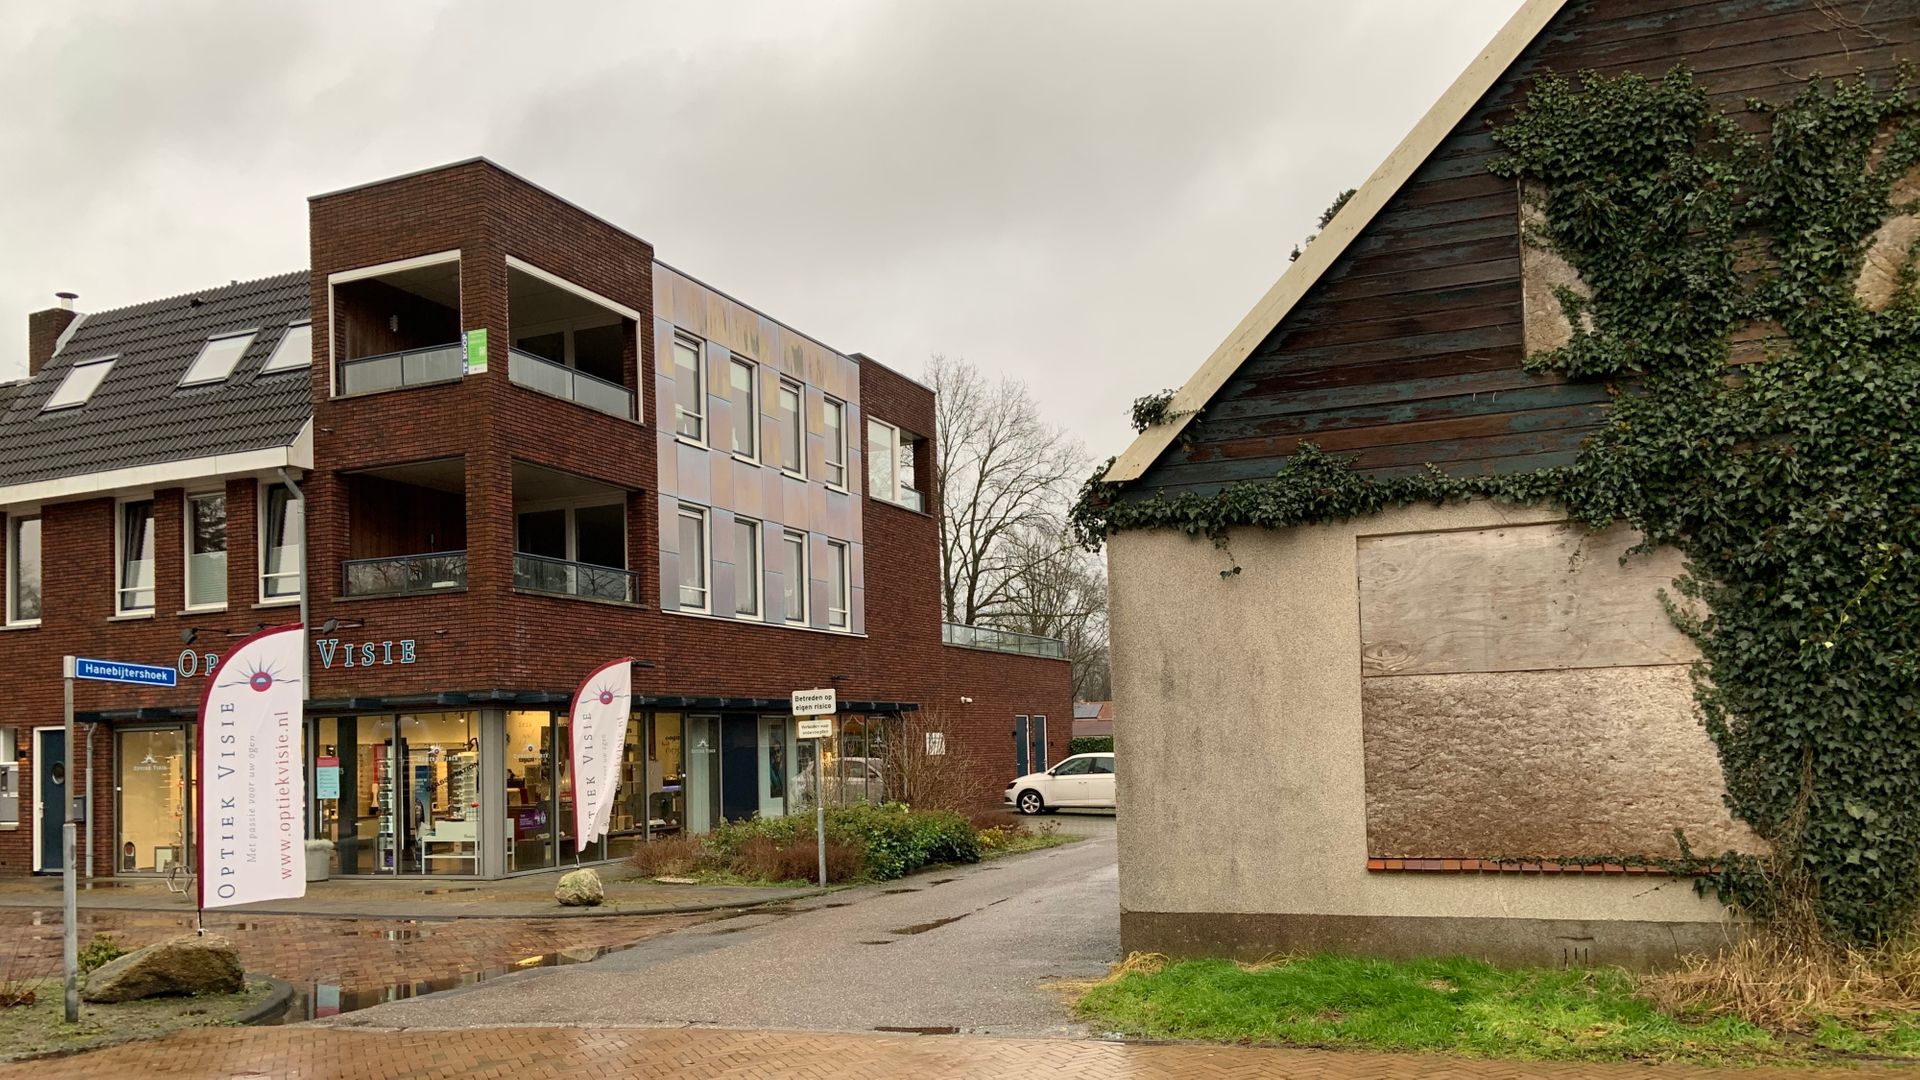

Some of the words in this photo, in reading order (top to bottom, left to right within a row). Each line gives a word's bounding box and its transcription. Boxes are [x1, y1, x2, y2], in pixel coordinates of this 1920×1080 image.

[316, 639, 416, 669] VISIE
[85, 663, 168, 681] Hanebijtershoek
[795, 704, 813, 712] eigen
[217, 702, 236, 780] VISIE
[248, 735, 258, 759] ogen
[248, 762, 256, 778] uw
[248, 782, 256, 805] voor
[274, 711, 295, 880] www.optiekvisie.nl
[246, 808, 258, 839] passie
[217, 797, 236, 899] OPTIEK
[246, 843, 257, 863] Met
